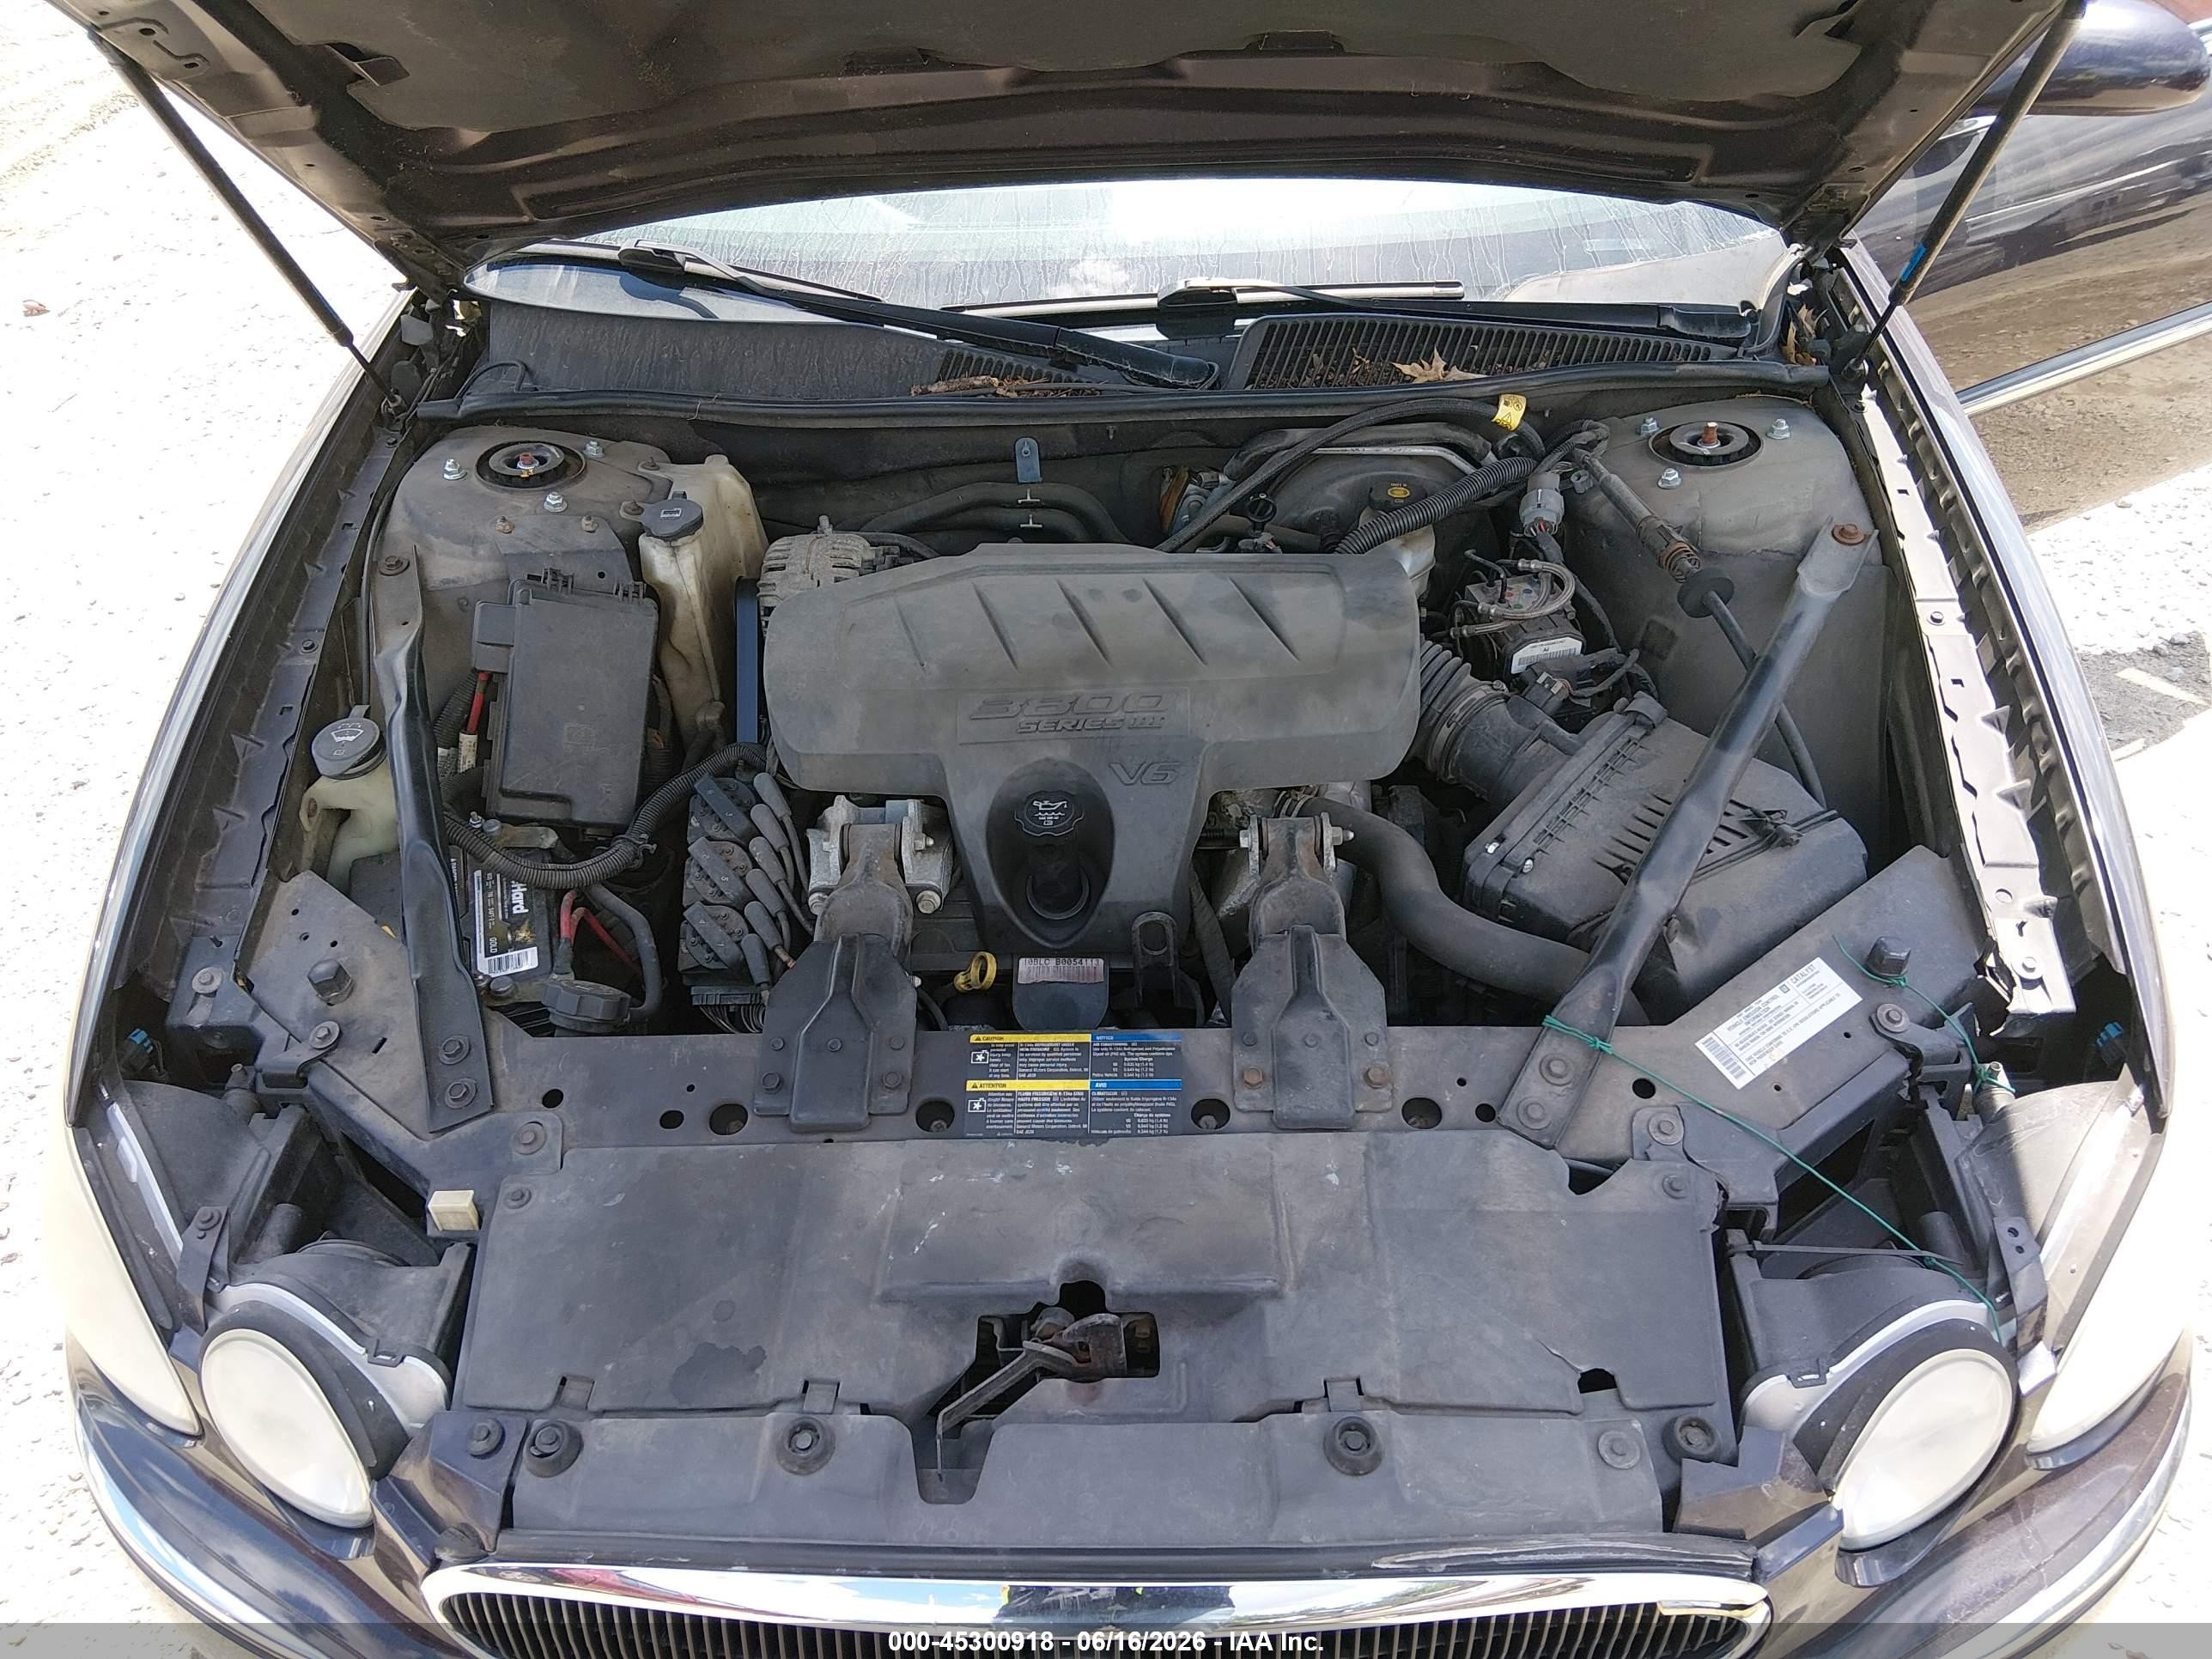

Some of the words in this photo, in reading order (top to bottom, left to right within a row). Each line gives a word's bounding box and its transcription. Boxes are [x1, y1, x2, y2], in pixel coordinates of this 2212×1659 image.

[970, 695, 1165, 720] 3800
[1017, 716, 1124, 734] SERIES
[1109, 762, 1181, 786] V6
[510, 880, 529, 914] Hard
[489, 937, 498, 953] GOLD
[1789, 963, 1816, 984] CATALYST
